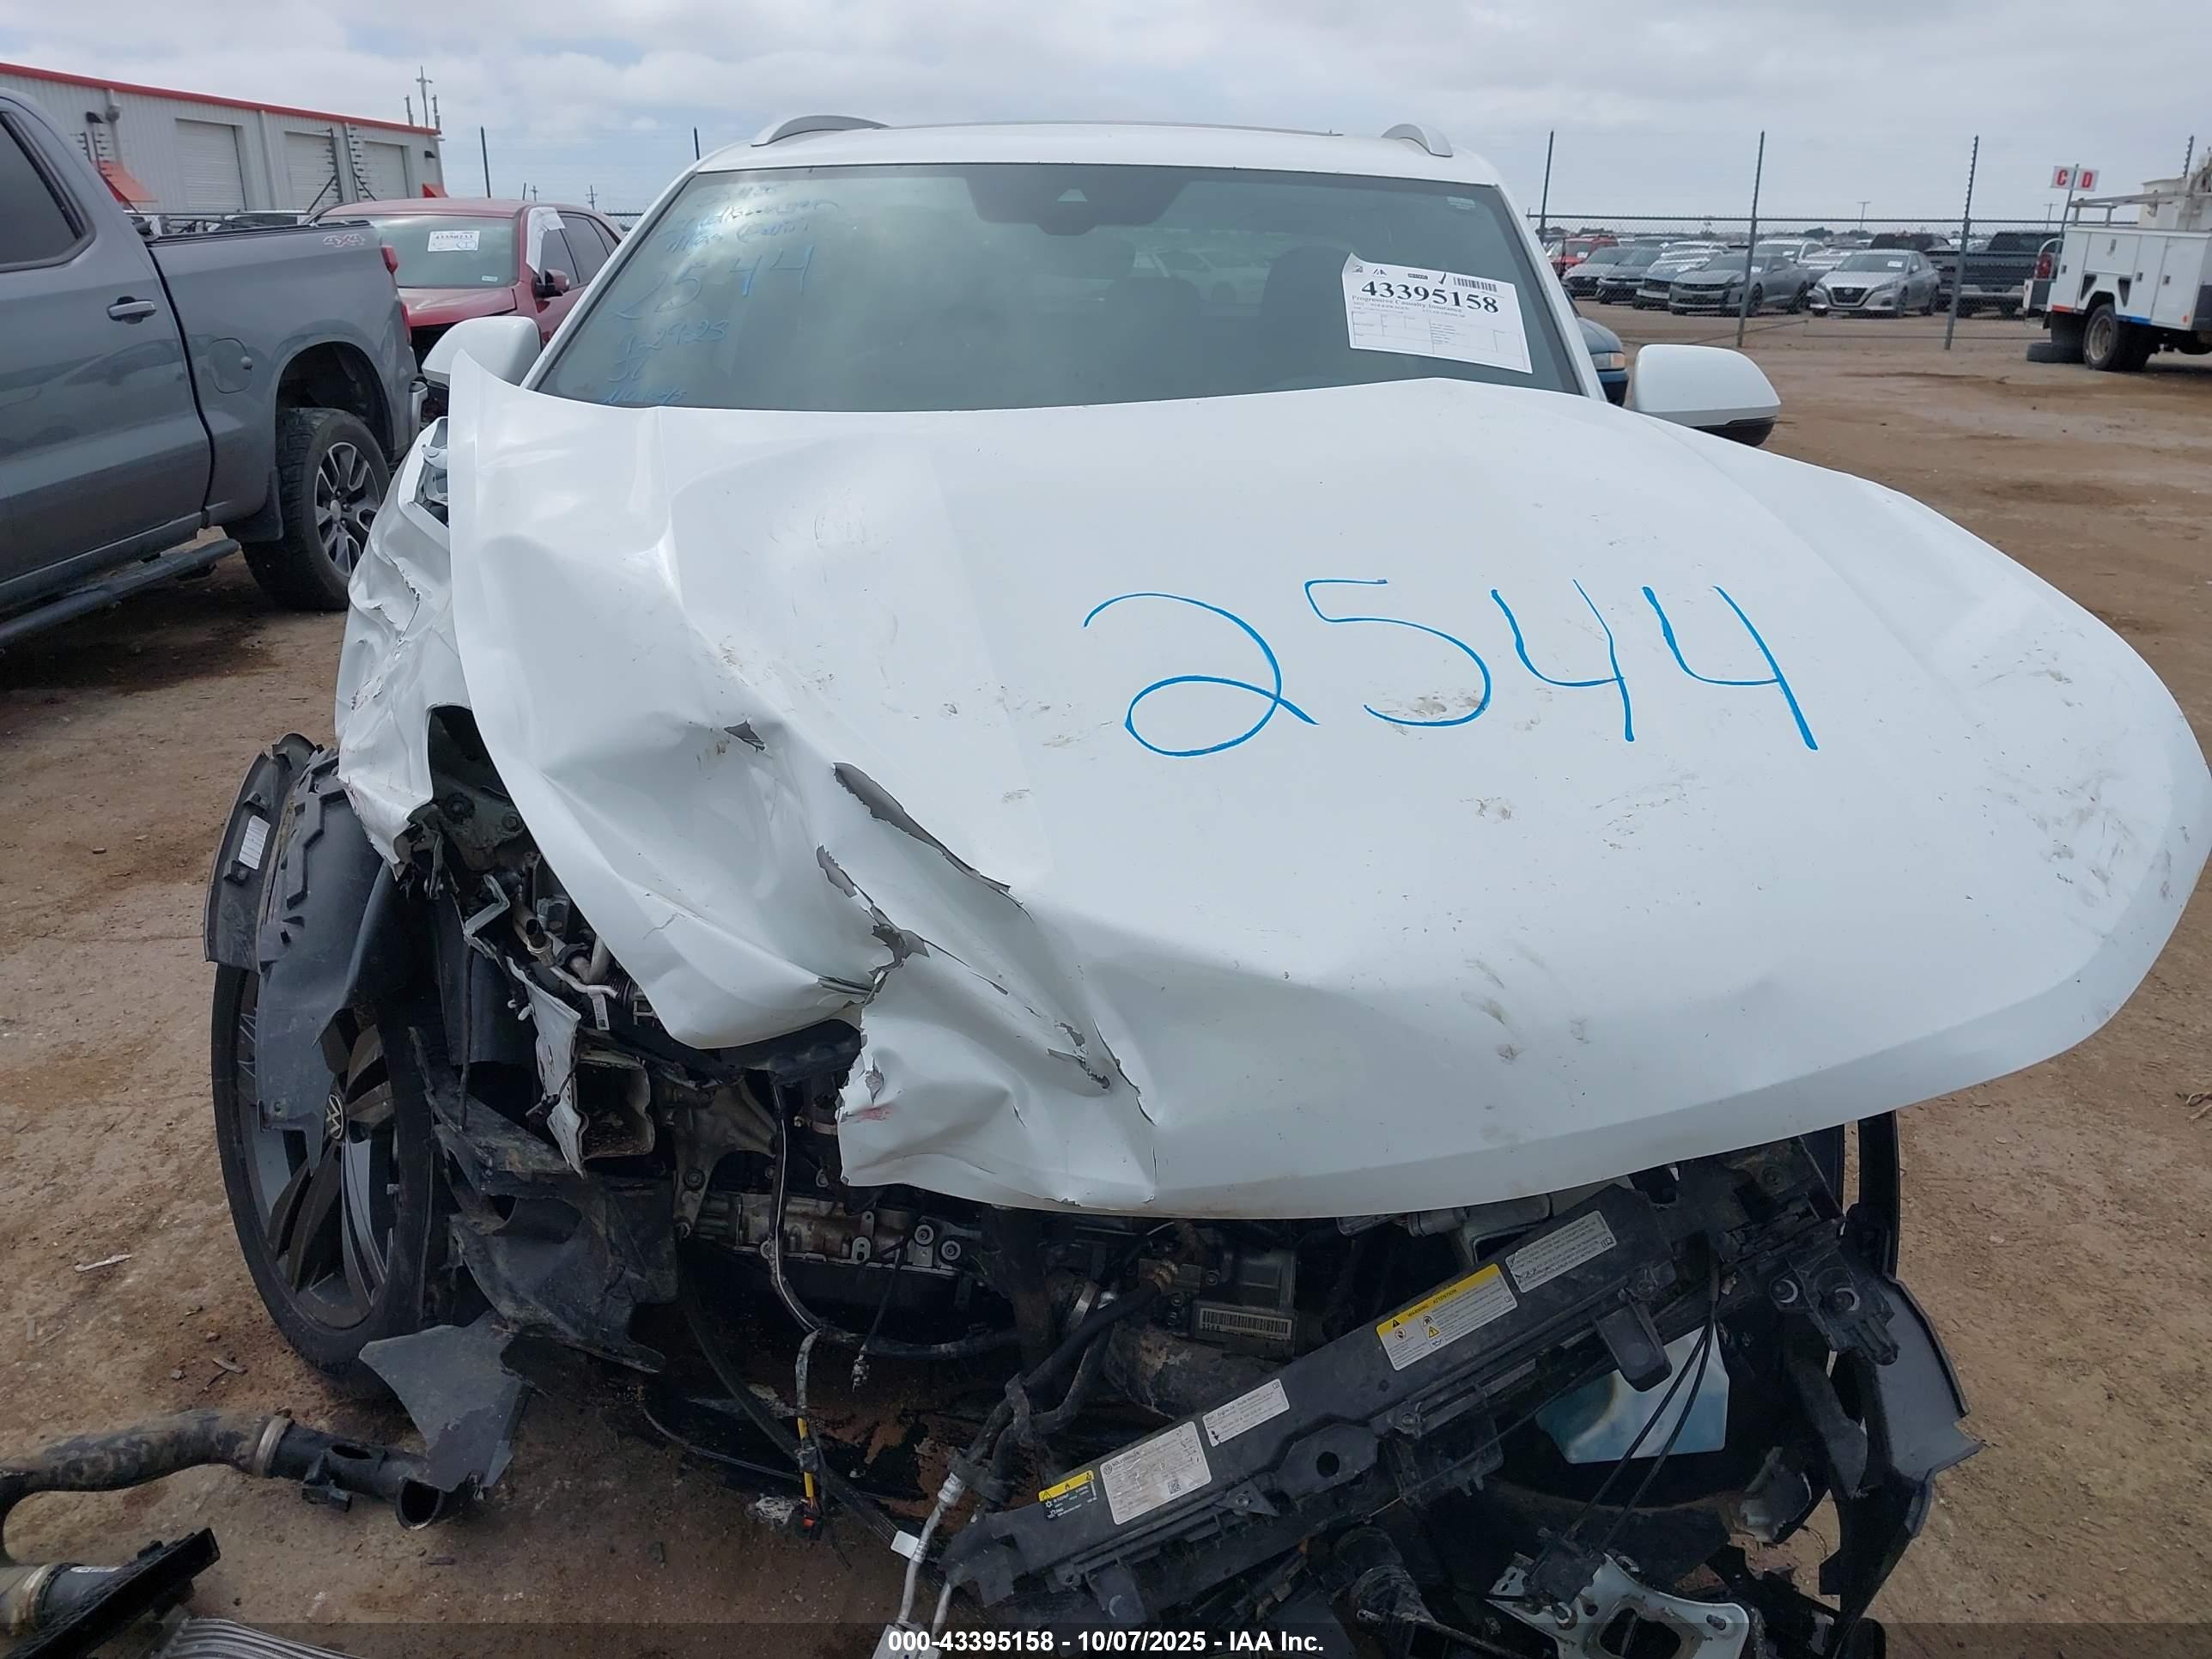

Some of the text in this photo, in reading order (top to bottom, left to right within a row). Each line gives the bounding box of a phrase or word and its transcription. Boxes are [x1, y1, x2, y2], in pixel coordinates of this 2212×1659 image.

[2057, 169, 2068, 186] C
[2081, 172, 2093, 188] D
[1361, 281, 1499, 313] 43395158
[1084, 579, 1818, 757] 2544
